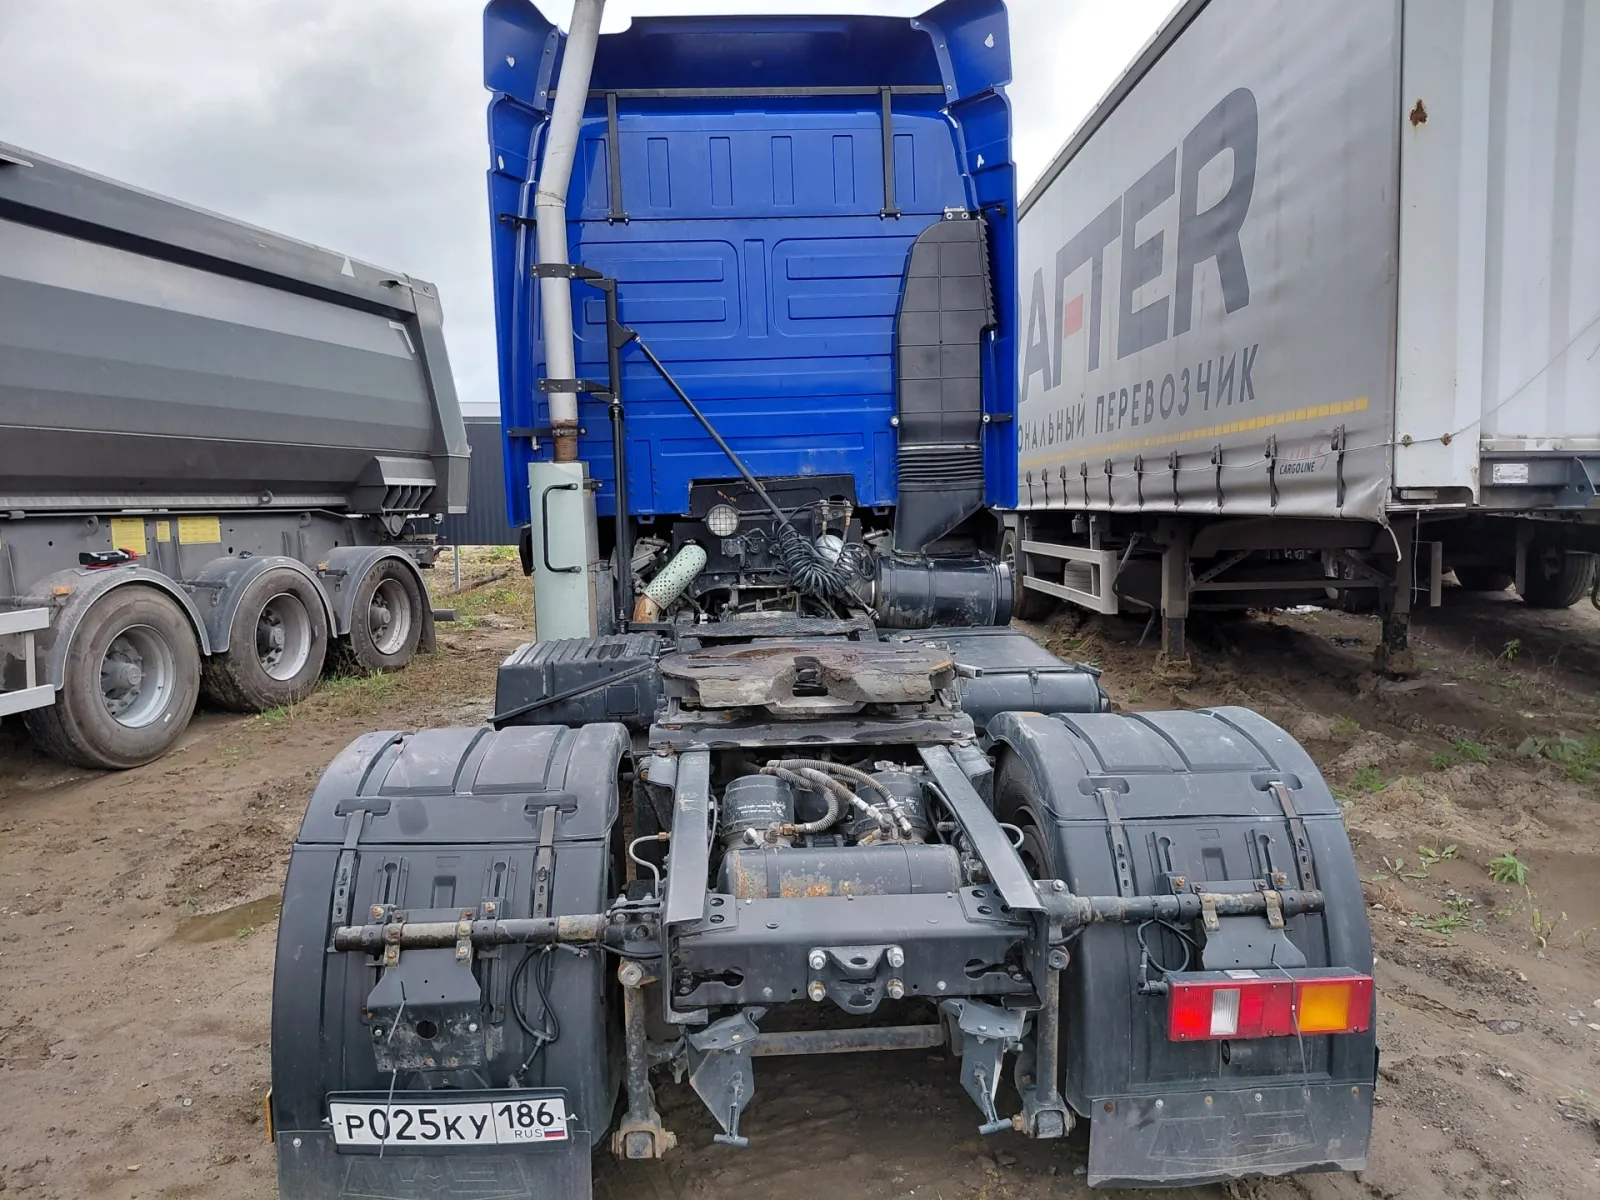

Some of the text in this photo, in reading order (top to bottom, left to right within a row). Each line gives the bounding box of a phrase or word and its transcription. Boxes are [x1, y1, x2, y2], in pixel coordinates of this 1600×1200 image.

[1018, 87, 1259, 404] AFTER
[1095, 344, 1259, 434] ПЕРЕВОЗЧИК
[1279, 461, 1316, 475] CARGOLINE
[498, 1102, 555, 1129] 186
[514, 1128, 543, 1139] RUS
